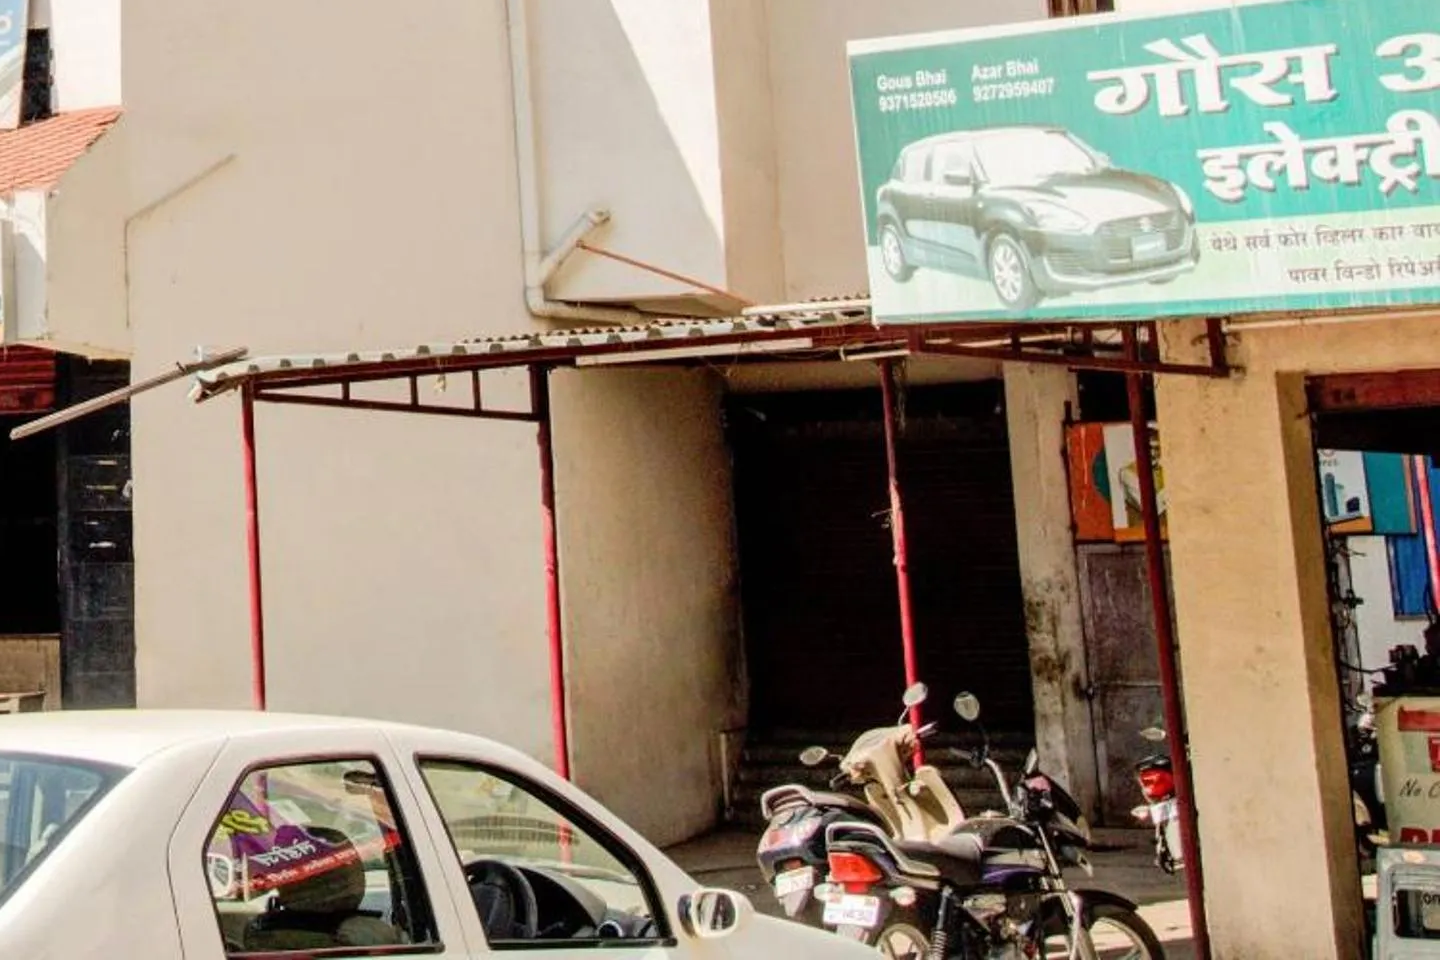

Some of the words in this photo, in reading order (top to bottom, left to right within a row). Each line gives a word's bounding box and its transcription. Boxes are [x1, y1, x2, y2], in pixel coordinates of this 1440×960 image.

[877, 74, 912, 92] Gous
[915, 69, 947, 87] Bhai
[971, 65, 1003, 82] Azar
[1006, 58, 1039, 76] Bhai
[1086, 33, 1339, 117] गौस
[1287, 266, 1327, 283] पावर
